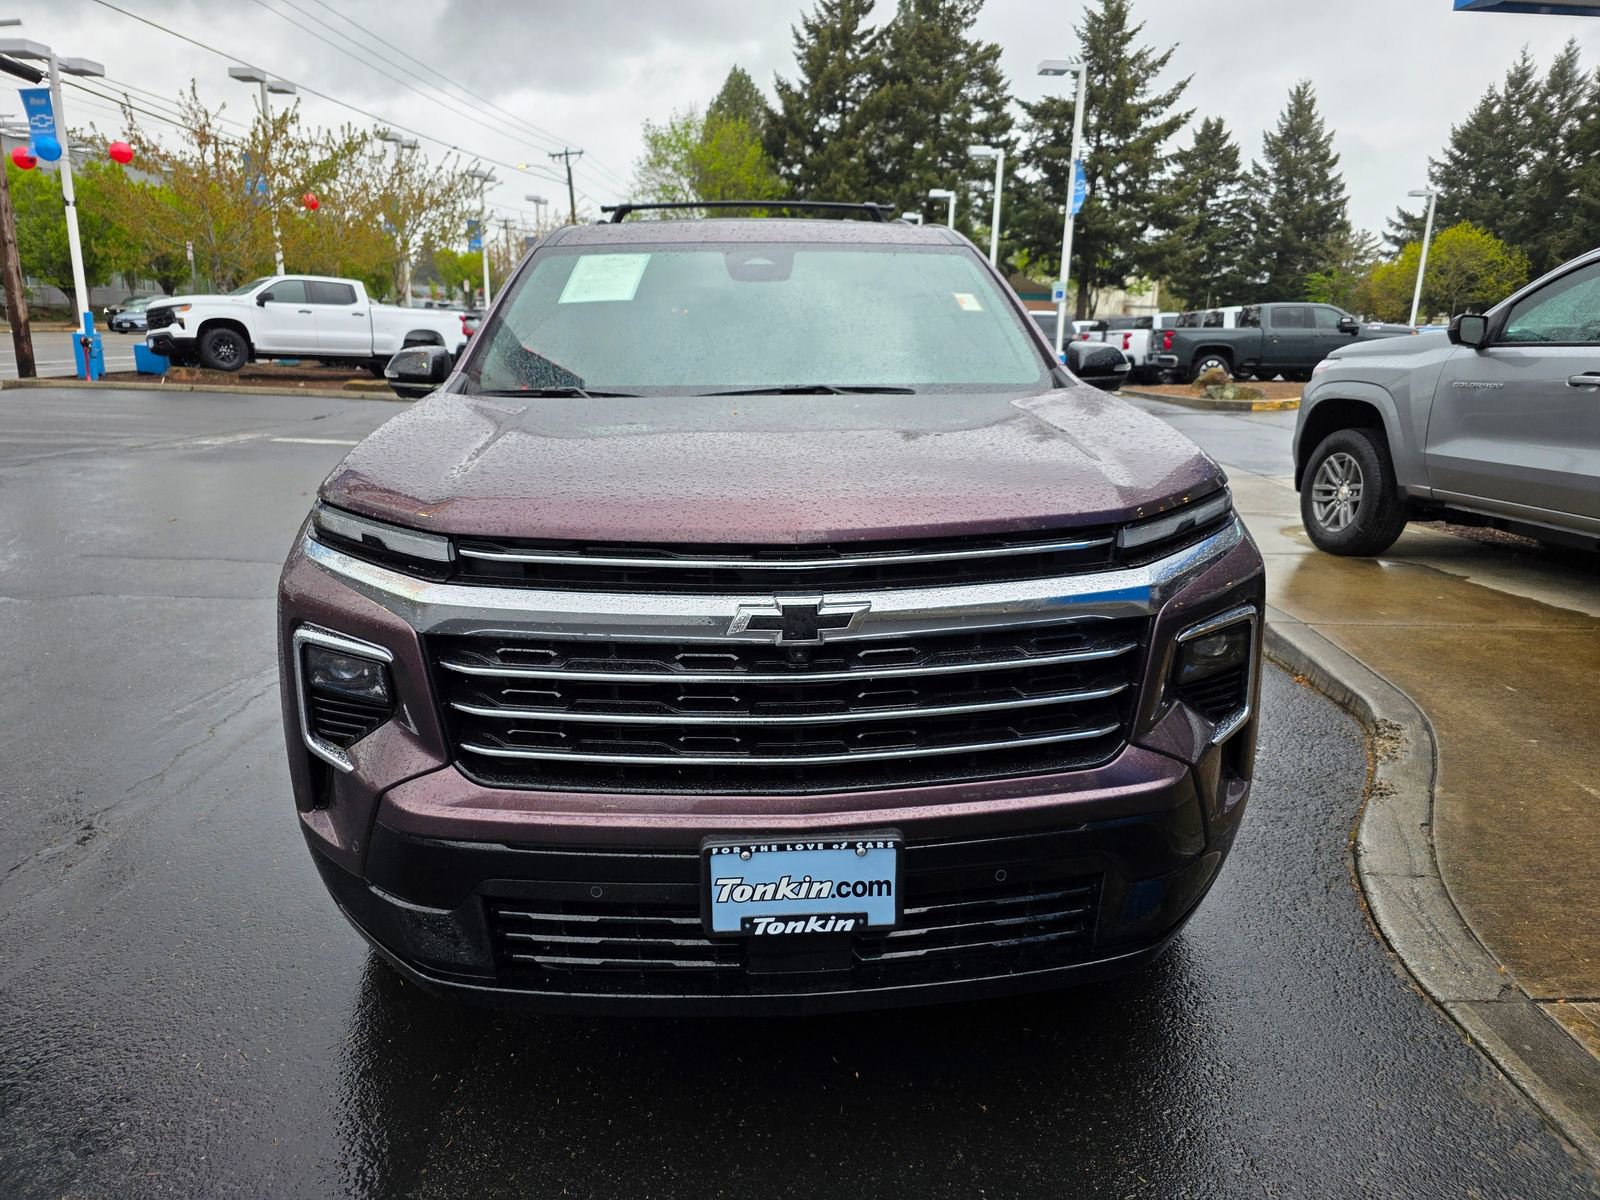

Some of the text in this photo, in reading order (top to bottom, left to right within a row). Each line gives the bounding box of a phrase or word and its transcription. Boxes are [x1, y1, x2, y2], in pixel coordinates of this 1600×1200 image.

[712, 841, 894, 855] FOR THE LOVE of CARS
[714, 874, 892, 904] Tonkin.com
[753, 915, 856, 935] Tonkin
